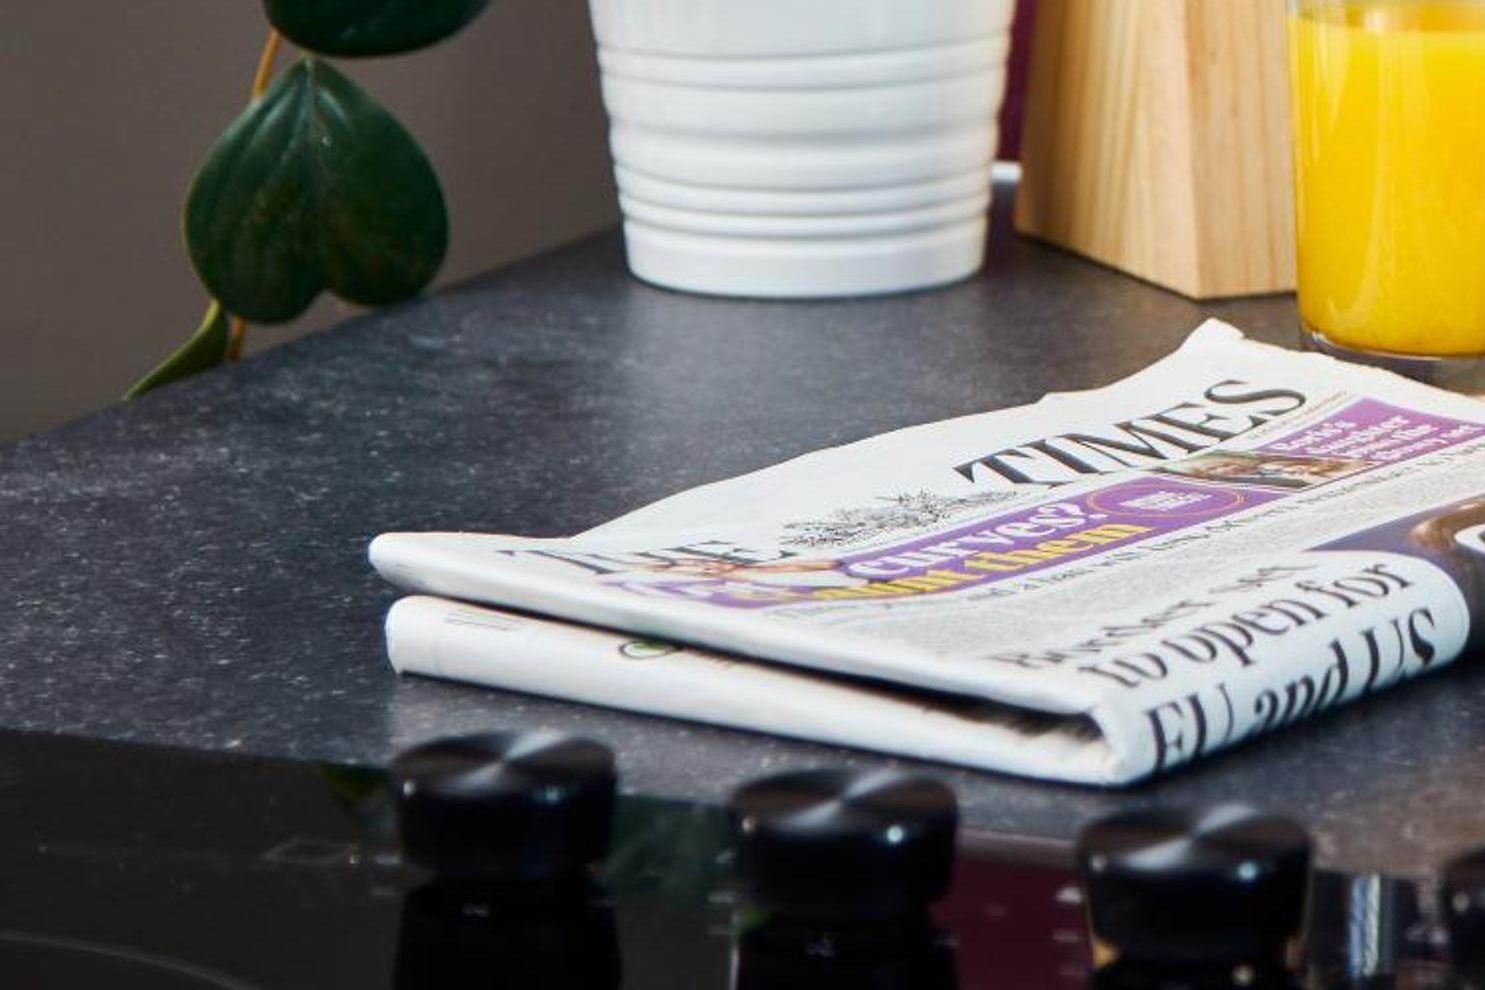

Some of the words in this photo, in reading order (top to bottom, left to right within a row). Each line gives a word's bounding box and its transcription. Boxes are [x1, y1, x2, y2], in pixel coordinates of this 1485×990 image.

[953, 378, 1306, 488] TIMES
[849, 502, 1108, 576] curves?
[962, 523, 1152, 572] them
[1077, 651, 1169, 689] to
[1160, 598, 1330, 667] open
[1293, 562, 1415, 609] for
[1145, 681, 1234, 772] EU
[1253, 639, 1350, 736] and
[1360, 605, 1436, 696] US
